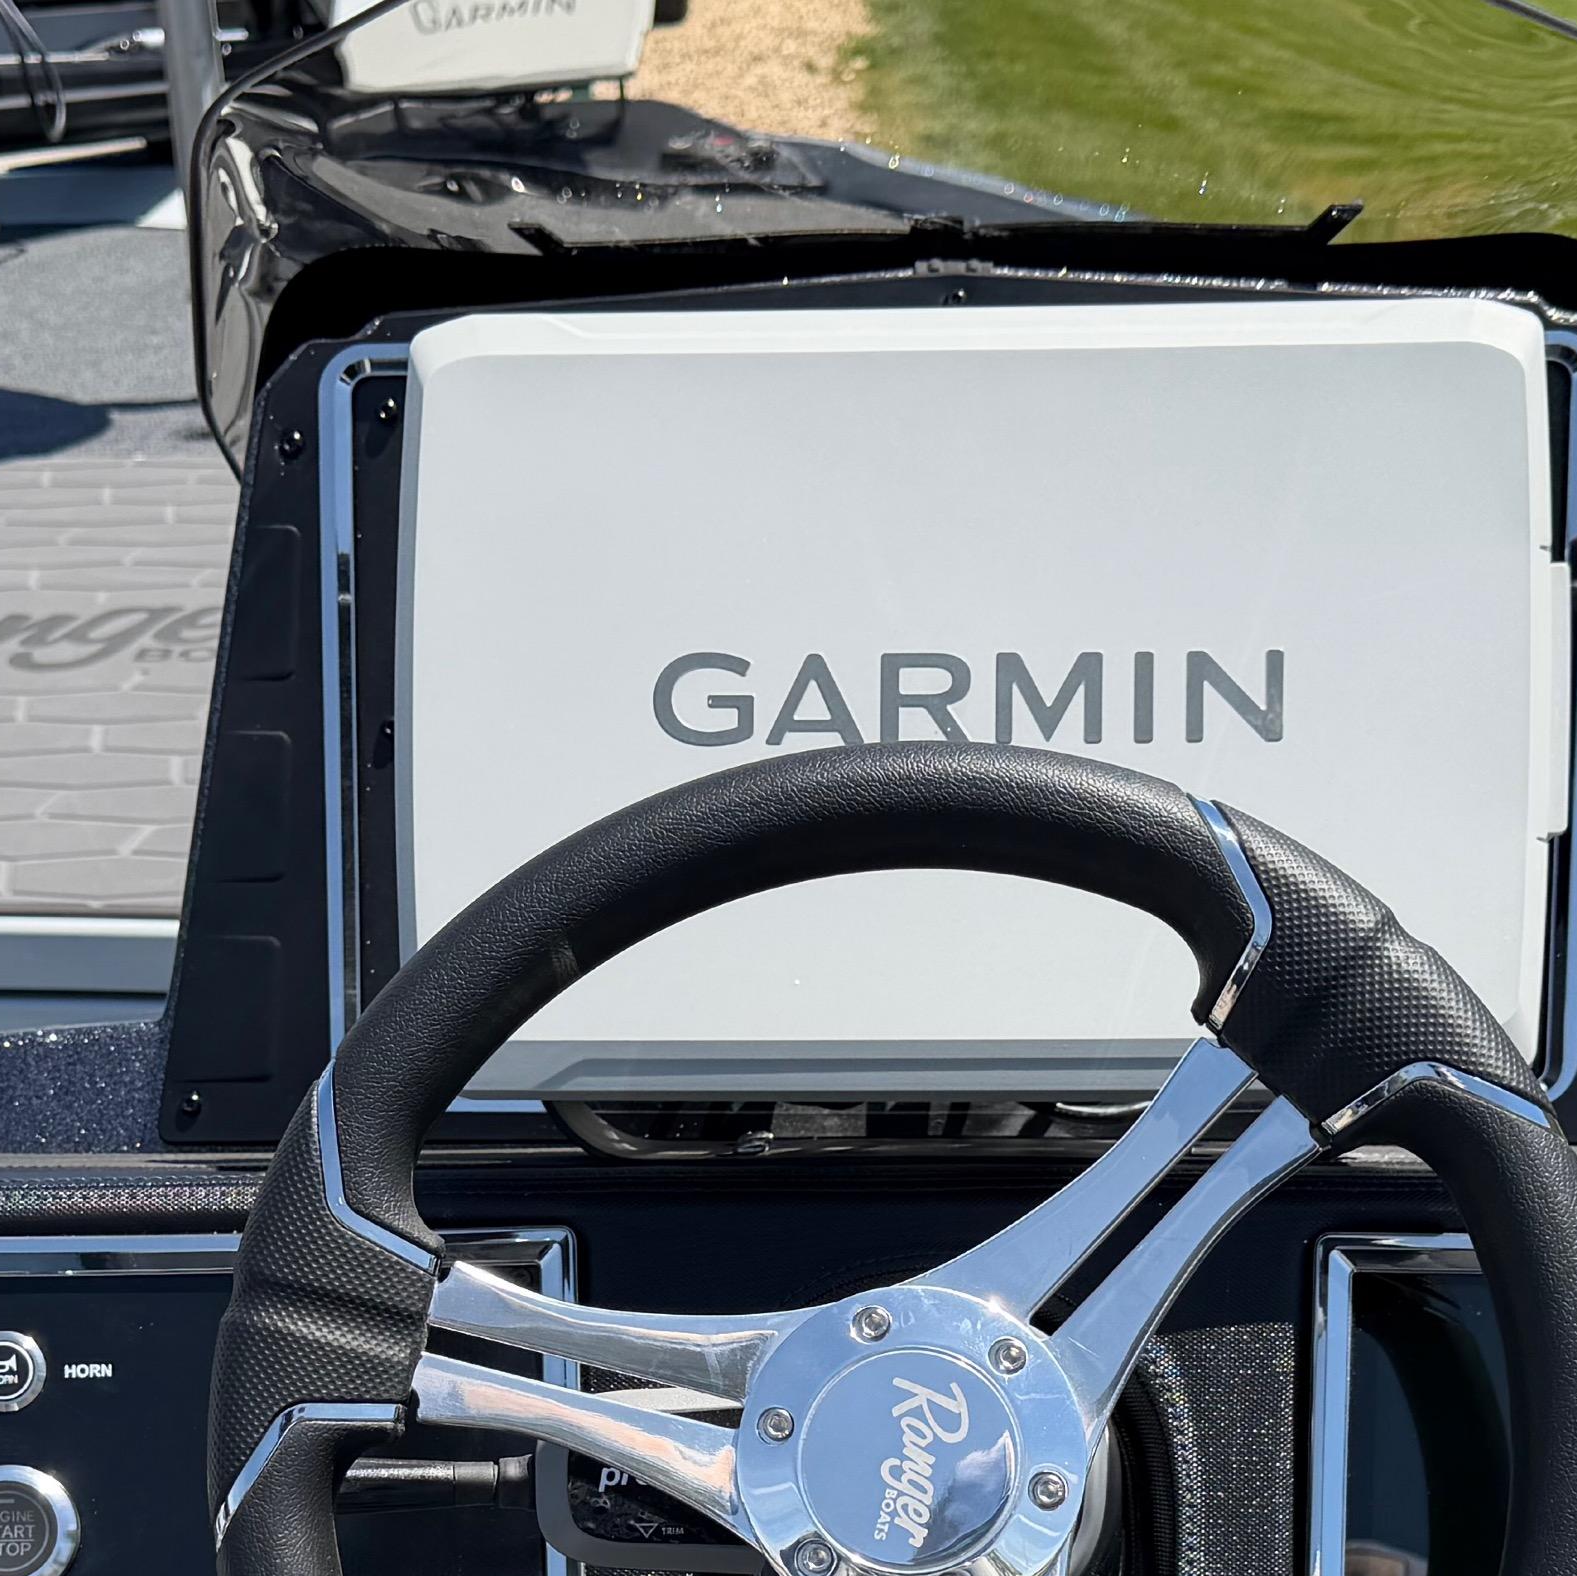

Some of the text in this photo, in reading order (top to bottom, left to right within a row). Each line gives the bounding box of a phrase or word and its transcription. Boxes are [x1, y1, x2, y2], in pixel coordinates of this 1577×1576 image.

[653, 649, 1284, 747] GARMIN
[63, 1363, 113, 1379] HORN
[598, 1466, 649, 1493] pr
[881, 1377, 970, 1548] Ranger
[874, 1488, 898, 1541] BOATS
